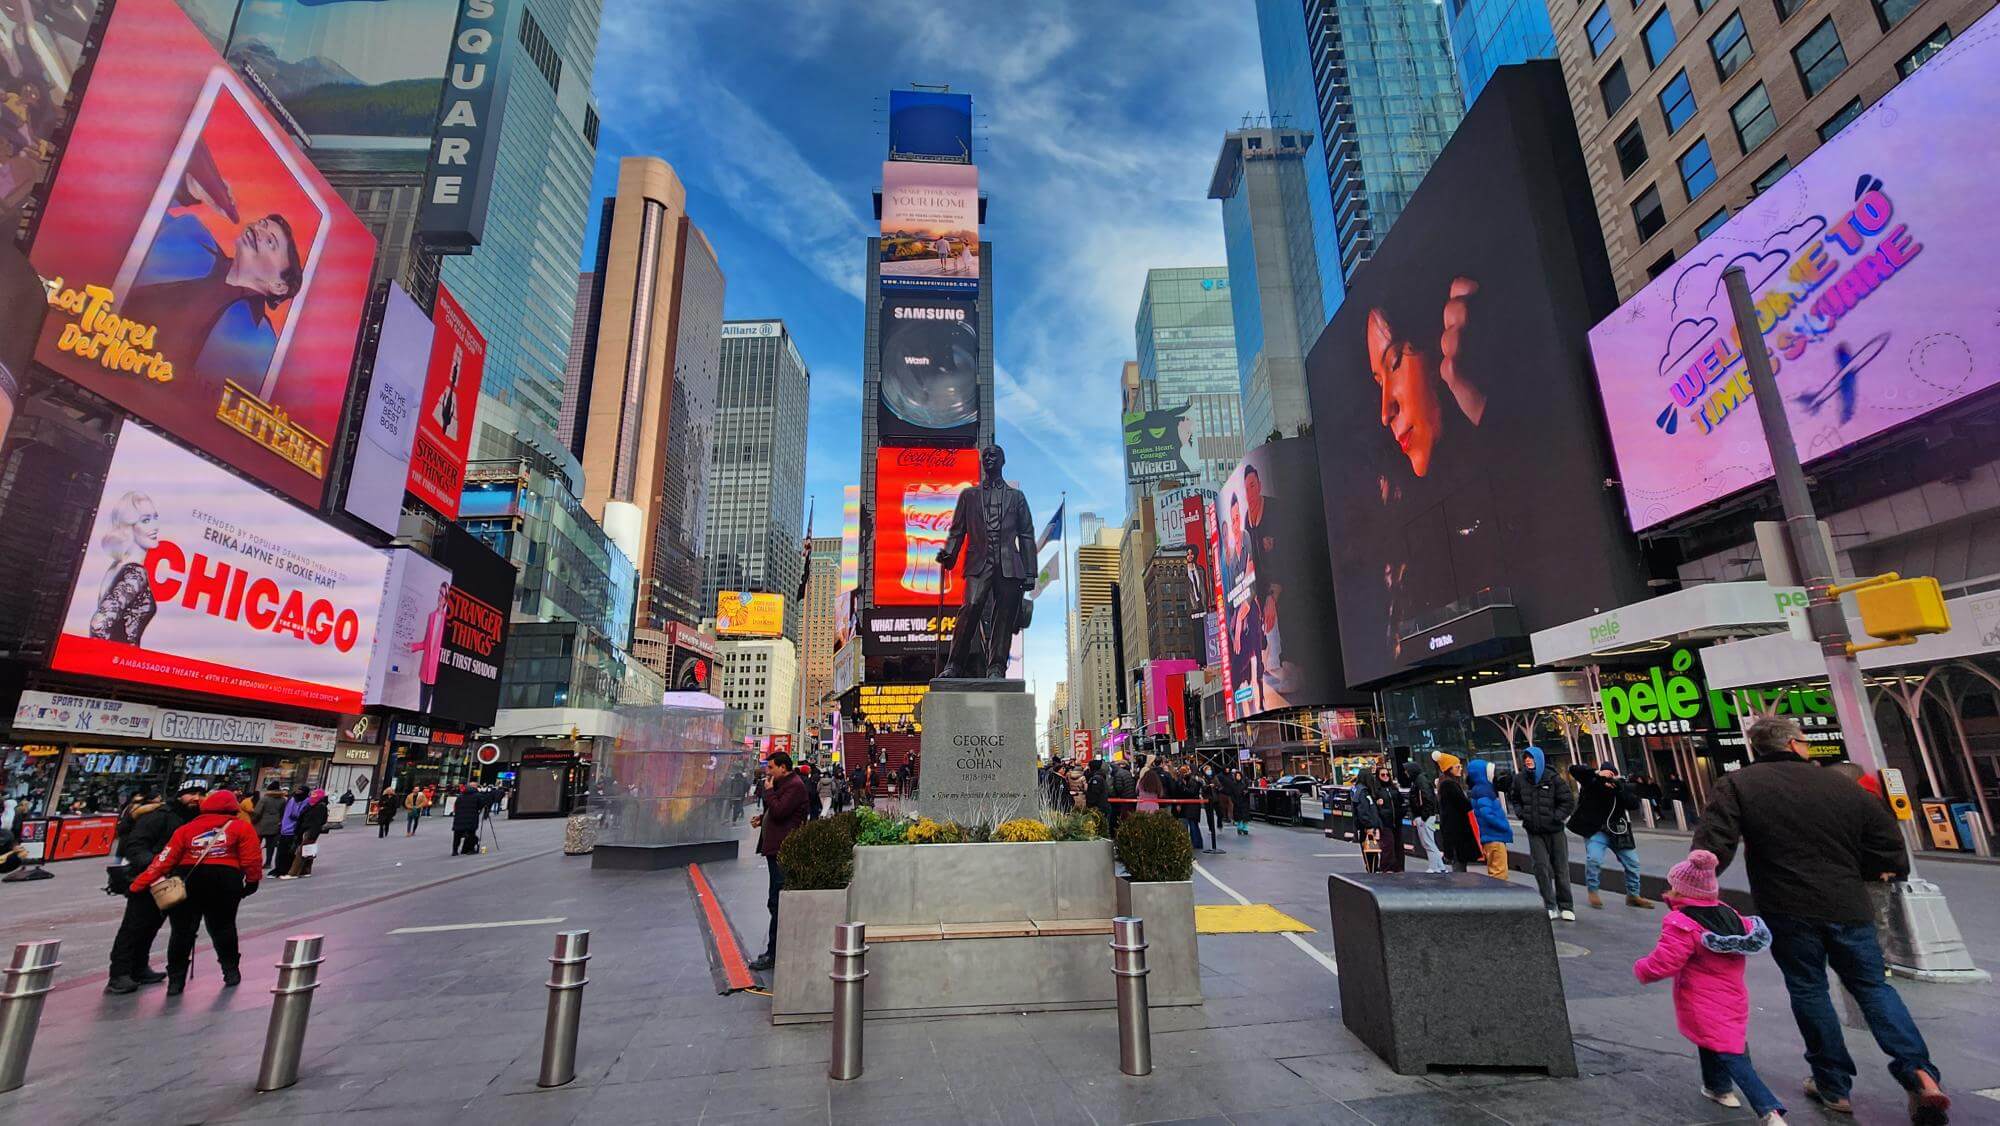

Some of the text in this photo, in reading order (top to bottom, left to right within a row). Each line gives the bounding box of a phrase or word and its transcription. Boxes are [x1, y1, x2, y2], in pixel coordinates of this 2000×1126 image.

[431, 0, 495, 205] SQUARE
[893, 196, 968, 208] YOUR HOME
[1825, 190, 1893, 256] TO
[40, 274, 158, 350] Los Tigres
[894, 307, 965, 320] SAMSUNG
[722, 326, 757, 335] Allianz
[57, 323, 174, 382] Del Norte
[904, 356, 930, 365] Wash
[385, 383, 406, 407] BE THE
[380, 416, 398, 436] BOSS
[383, 406, 399, 424] BEST
[416, 438, 459, 489] STRANGER
[420, 460, 451, 493] THINGS
[1160, 488, 1218, 509] LITTLE SHOP
[192, 509, 235, 533] EXTENDED
[237, 526, 247, 537] BY
[249, 534, 281, 552] POPULAR
[203, 527, 337, 591] ERIKA JAYNE IS ROXIE HART
[143, 540, 359, 653] CHICAGO
[446, 590, 504, 643] STRANGER
[870, 618, 894, 632] WHAT
[894, 618, 910, 631] ARE
[911, 617, 927, 631] YOU
[451, 620, 492, 657] THINGS
[119, 657, 170, 674] AMBASSADOR
[171, 667, 199, 679] THEATRE
[452, 649, 472, 672] FIRST
[472, 658, 499, 680] SHADOW
[51, 695, 123, 712] SPORTS FAN SHOP
[1600, 648, 1700, 738] pelé
[161, 711, 266, 743] GRAND SLAM
[397, 722, 430, 737] BLUE FIN
[1626, 719, 1691, 737] SOCCER
[953, 735, 1005, 746] GEORGE
[1075, 731, 1089, 766] tkts
[956, 758, 1002, 769] COHAN
[974, 747, 986, 758] M
[85, 754, 152, 774] GRAND
[184, 755, 231, 775] SLAM
